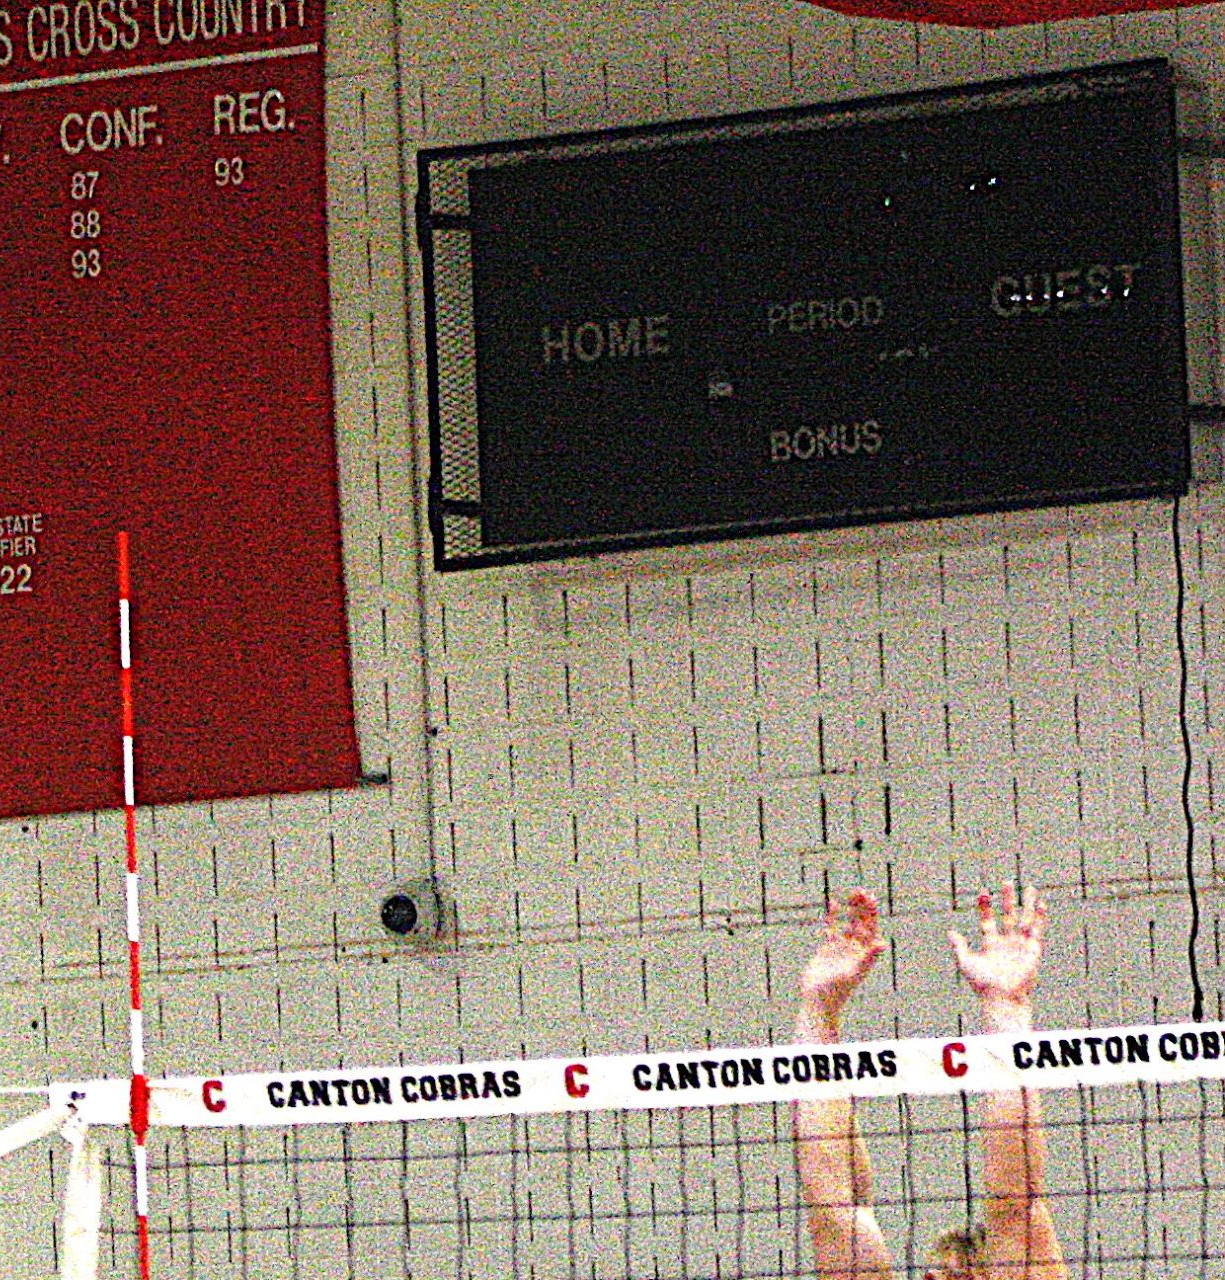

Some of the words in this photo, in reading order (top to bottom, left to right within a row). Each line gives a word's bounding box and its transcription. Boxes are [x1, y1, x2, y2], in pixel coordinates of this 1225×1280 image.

[27, 0, 140, 61] CROSS
[60, 105, 163, 154] CONF.
[214, 89, 295, 136] REG.
[71, 172, 99, 200] 87
[215, 158, 244, 186] 93
[71, 211, 101, 239] 88
[72, 250, 101, 279] 93
[990, 263, 1142, 318] GUEST
[767, 296, 884, 333] PERIOD
[542, 313, 671, 362] HOME
[769, 419, 883, 463] BONUS
[0, 564, 33, 595] 22
[202, 1080, 226, 1113] C
[267, 1077, 393, 1108] CANTON
[401, 1070, 522, 1101] COBRAS
[565, 1064, 591, 1099] C
[632, 1058, 764, 1093] CANTON
[773, 1050, 897, 1085] COBRAS
[943, 1042, 969, 1078] C
[1013, 1034, 1150, 1071] CANTON
[1158, 1031, 1225, 1061] COB
